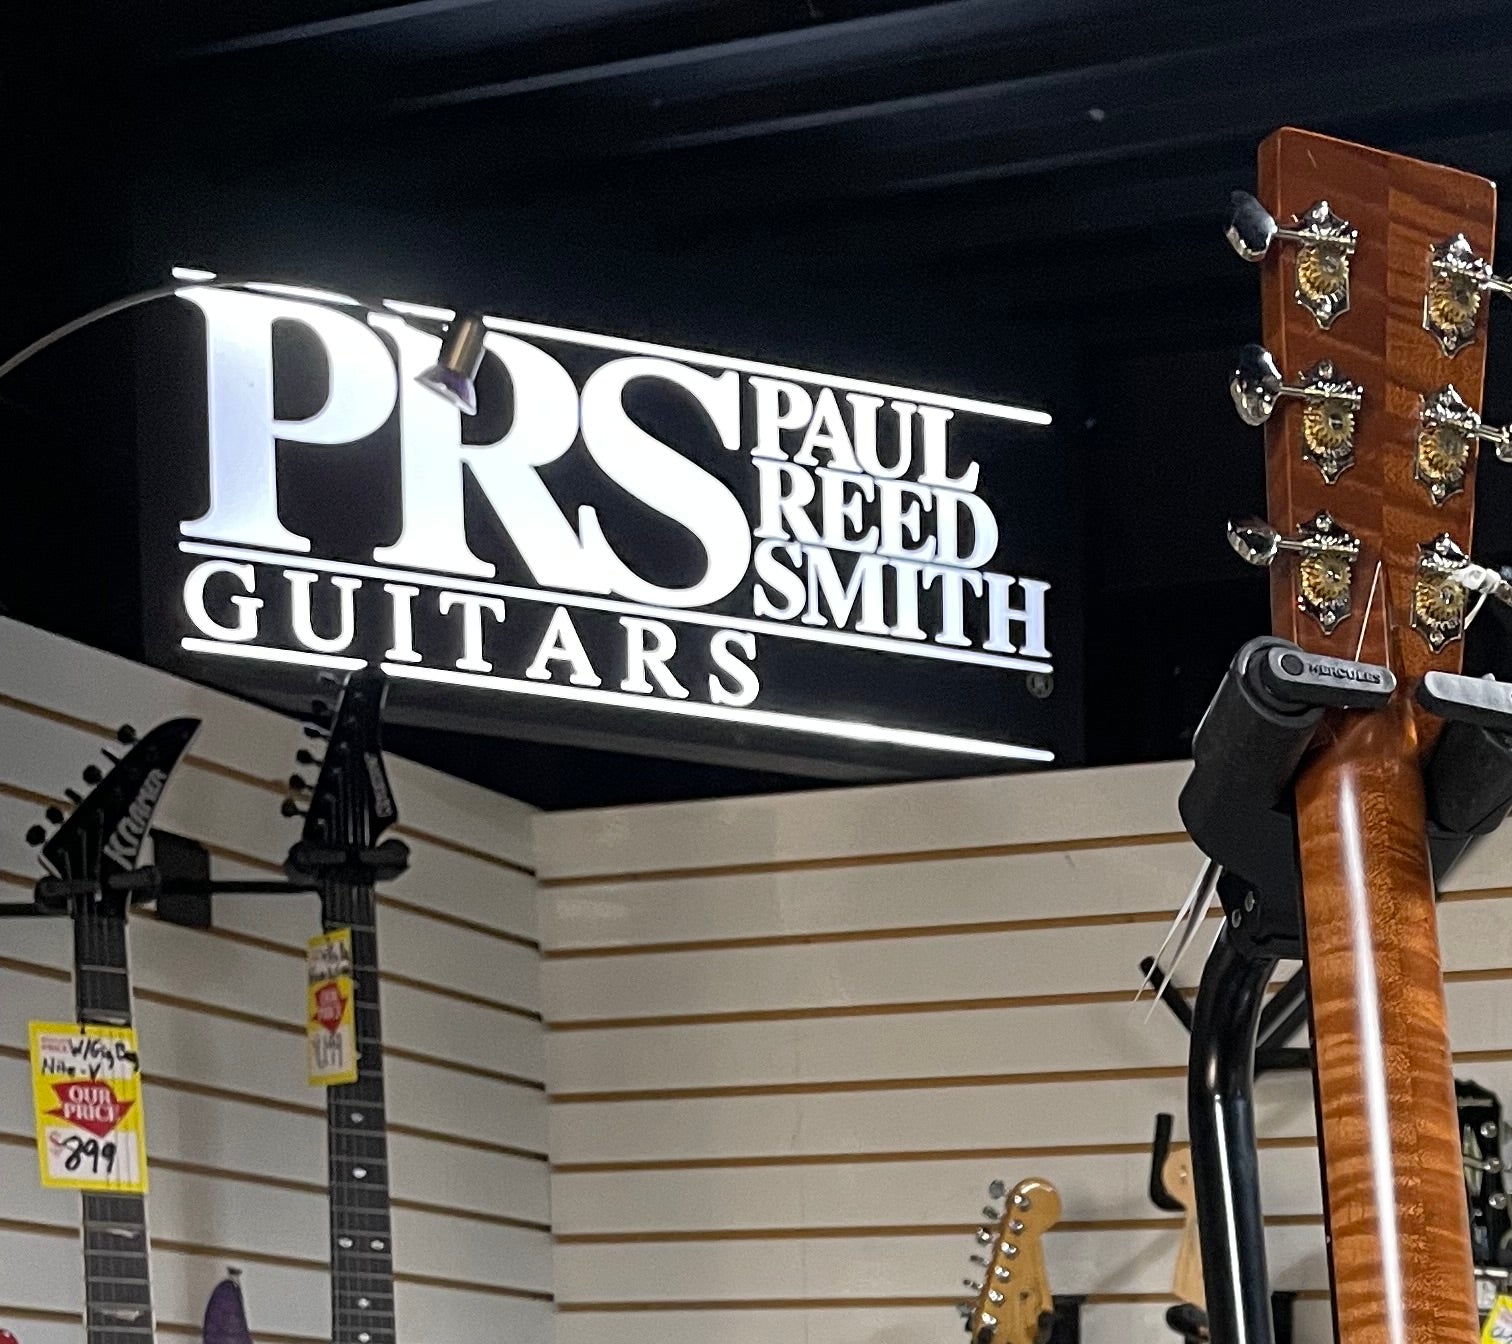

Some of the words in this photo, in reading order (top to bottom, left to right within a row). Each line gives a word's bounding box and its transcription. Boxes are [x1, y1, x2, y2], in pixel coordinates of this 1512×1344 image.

[173, 285, 753, 610] PRS
[748, 375, 980, 492] PAUL
[750, 456, 1000, 573] REED
[181, 559, 763, 709] GUITARS
[752, 538, 1053, 660] SMITH
[1308, 663, 1381, 684] HERCULES
[63, 1102, 119, 1123] PRICE
[68, 1084, 112, 1105] OUR
